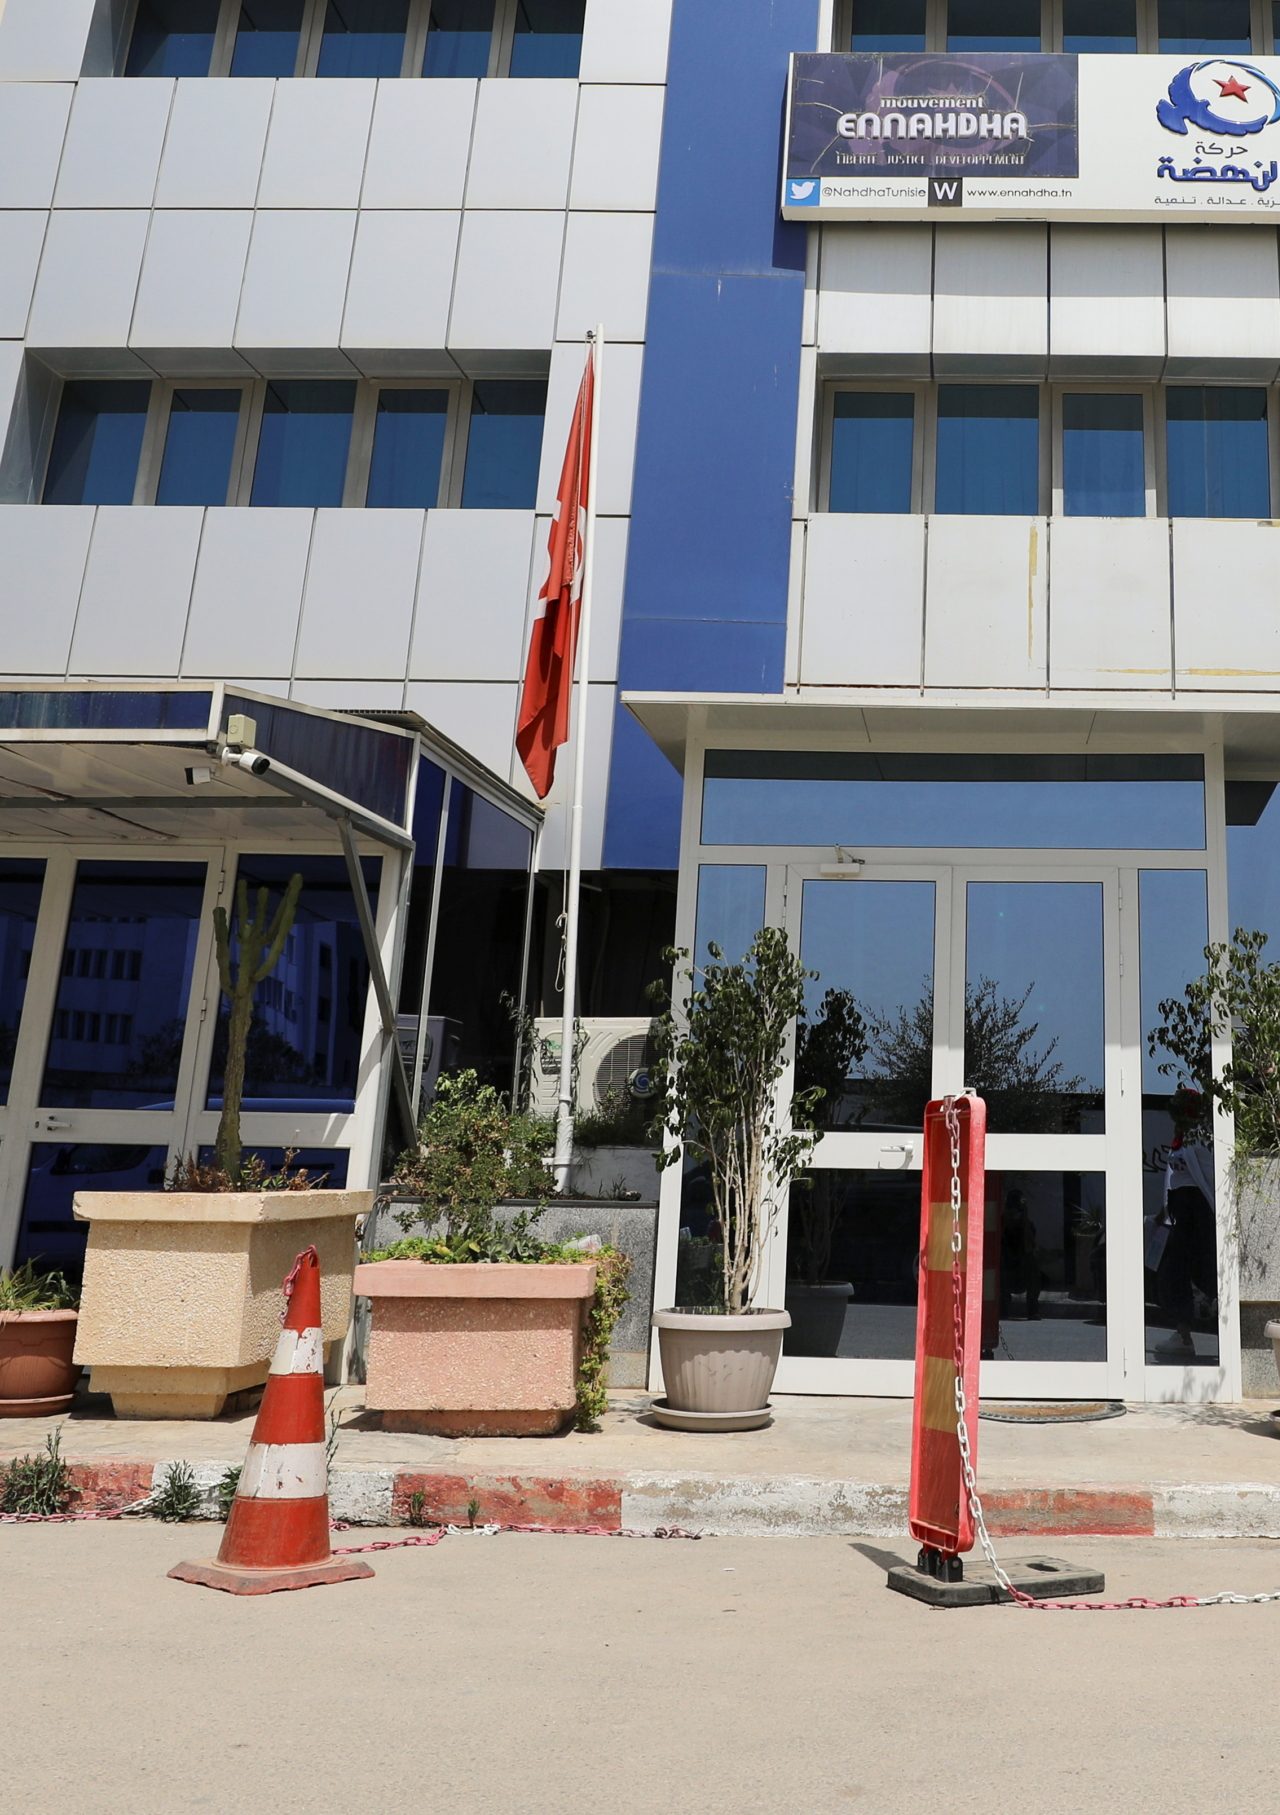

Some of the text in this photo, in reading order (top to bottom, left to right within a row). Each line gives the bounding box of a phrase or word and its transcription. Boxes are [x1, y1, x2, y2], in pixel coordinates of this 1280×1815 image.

[880, 96, 983, 108] mouvement
[1195, 141, 1248, 158] حركة
[822, 184, 926, 198] @NahdhaTunisie
[967, 186, 1072, 198] www.ennahdha.tn
